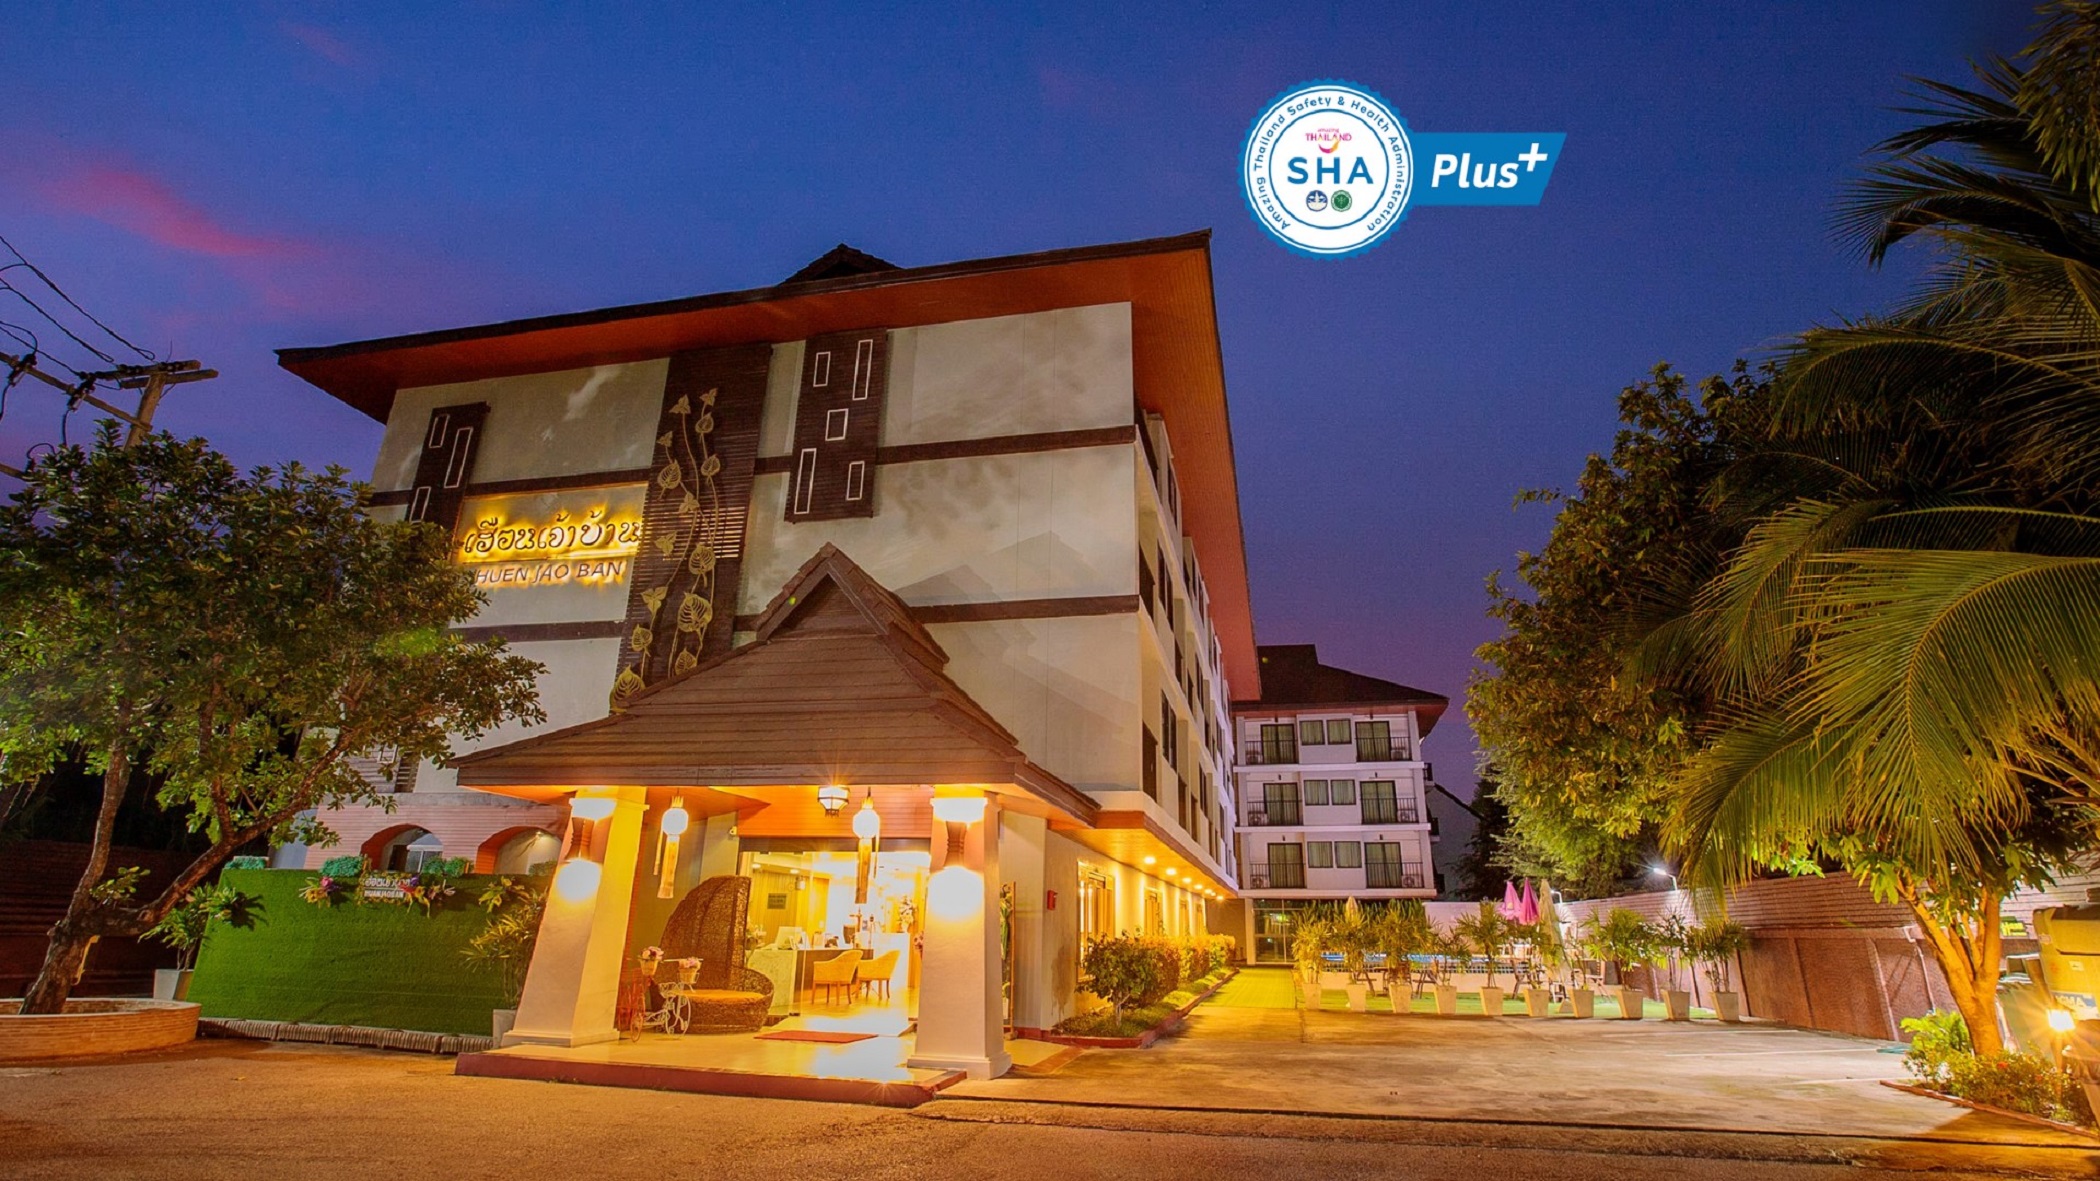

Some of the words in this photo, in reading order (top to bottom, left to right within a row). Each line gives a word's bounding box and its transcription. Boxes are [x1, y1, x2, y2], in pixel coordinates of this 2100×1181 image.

[464, 510, 641, 553] เฮือนเจ้าบ้าน
[475, 566, 528, 583] HUEN
[532, 564, 569, 583] JAO
[576, 561, 622, 578] BAN
